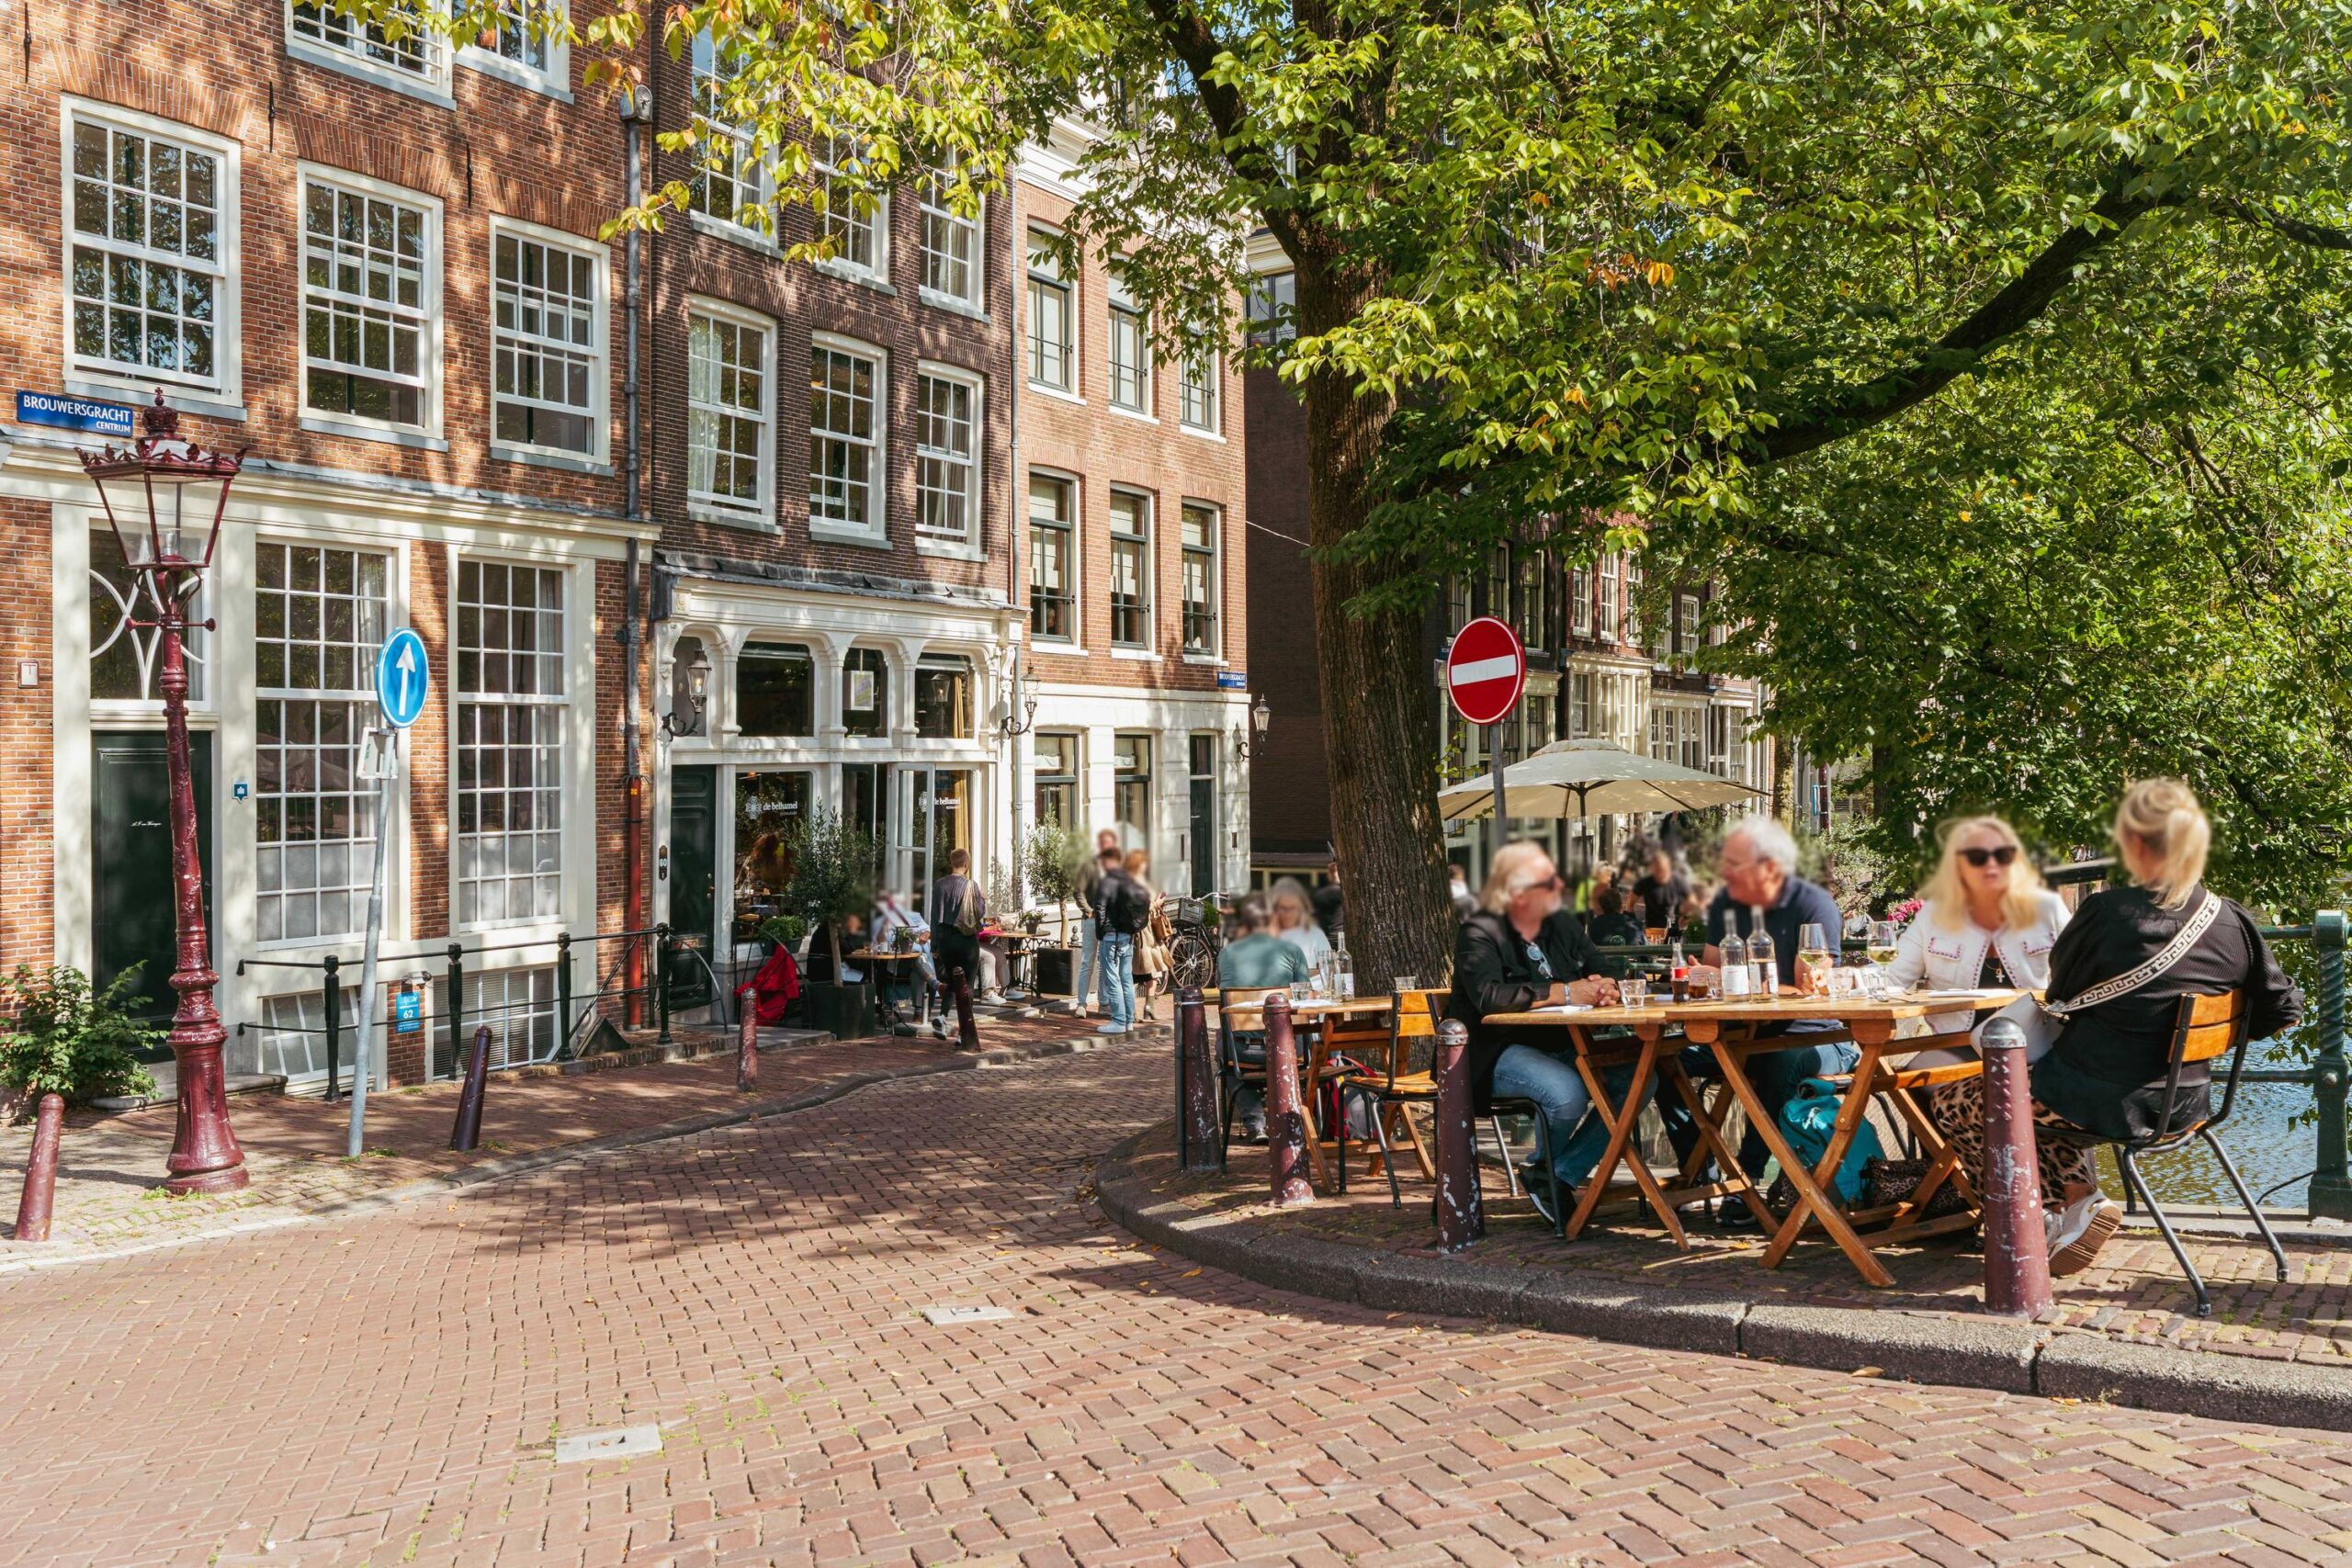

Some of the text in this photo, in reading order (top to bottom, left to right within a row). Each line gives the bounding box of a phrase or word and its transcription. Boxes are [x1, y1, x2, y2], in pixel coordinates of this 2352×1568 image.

[23, 395, 130, 423] BROUWERSGRACHT
[96, 422, 130, 433] CENTRUM
[763, 801, 797, 810] de belhamel
[403, 1010, 413, 1019] 62
